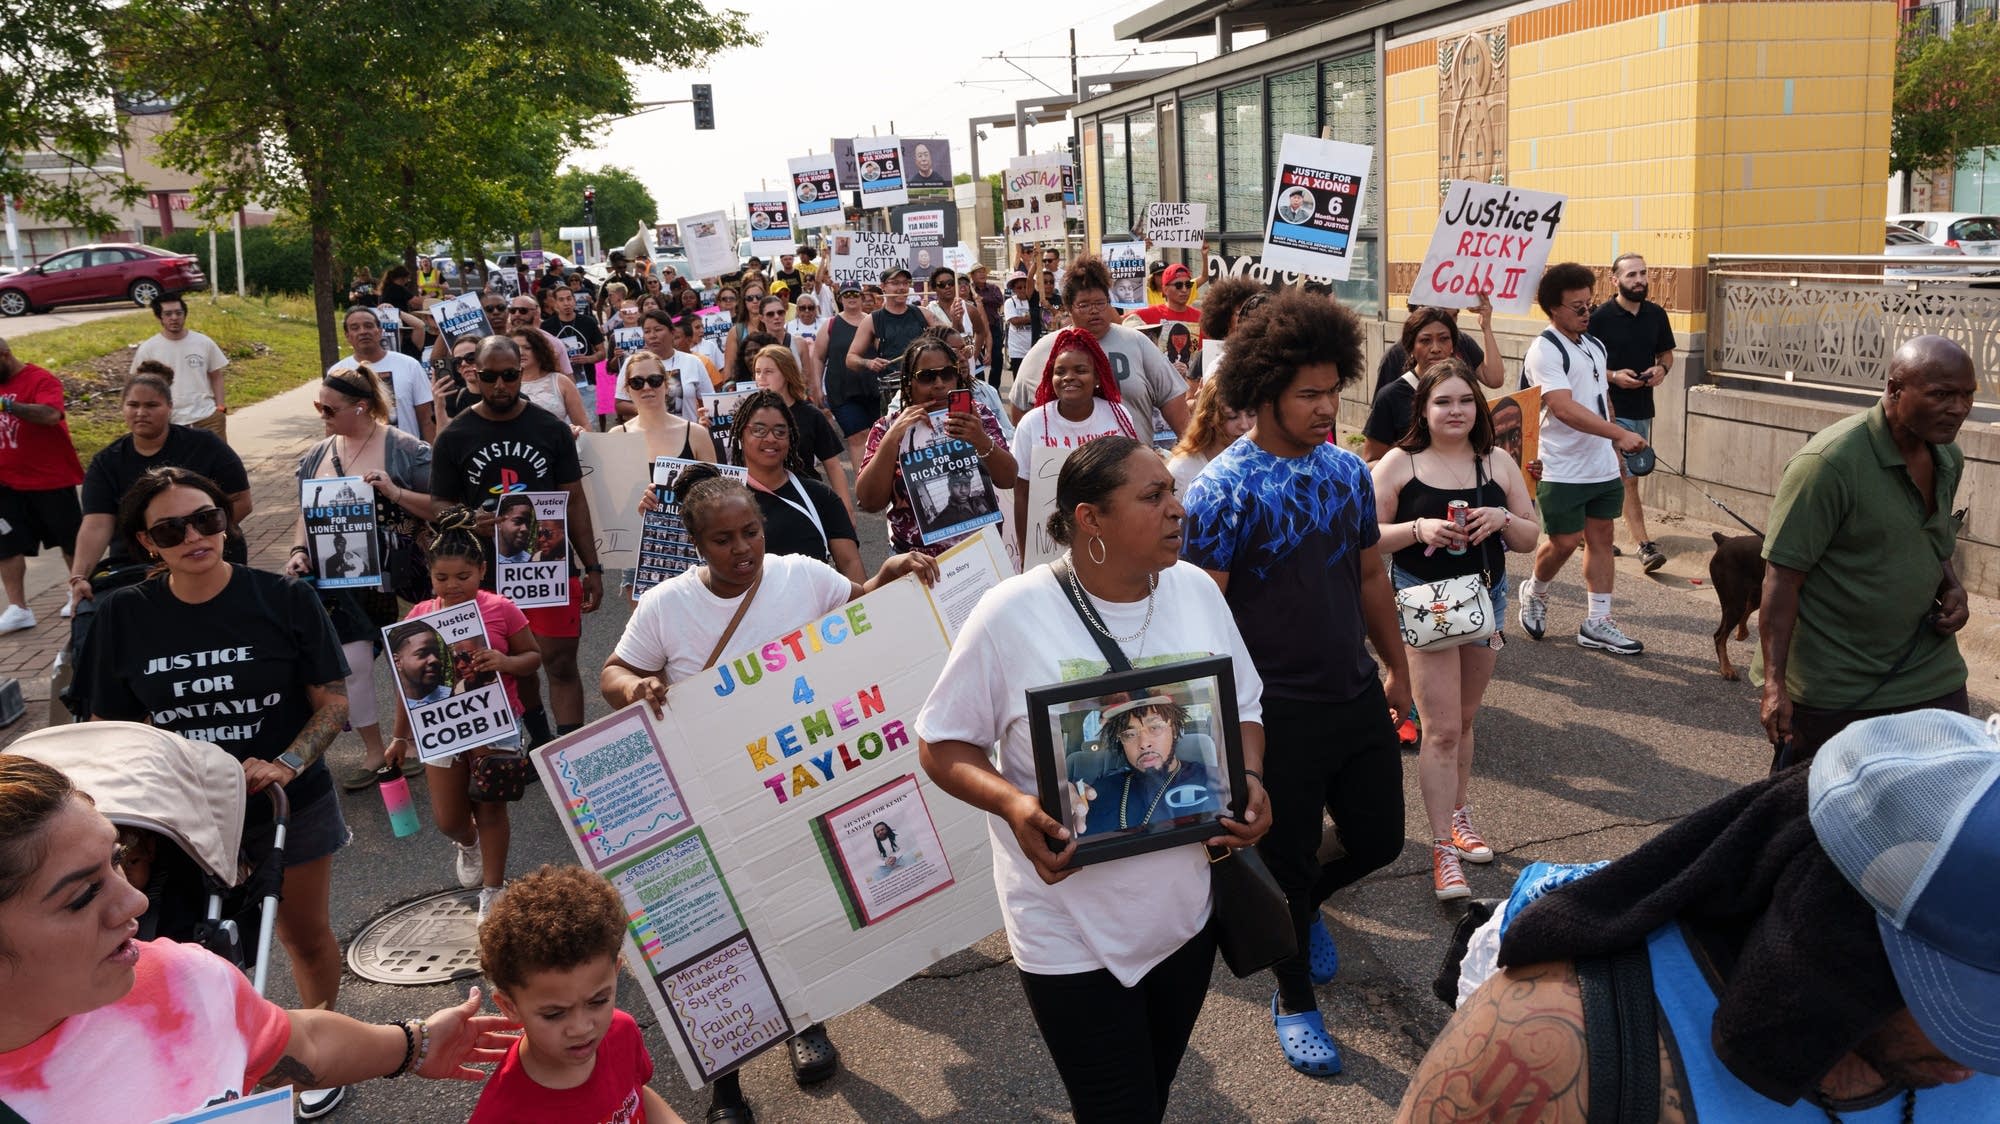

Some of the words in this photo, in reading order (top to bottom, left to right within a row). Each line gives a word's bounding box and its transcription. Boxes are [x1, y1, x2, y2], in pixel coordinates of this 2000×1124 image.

[886, 160, 893, 170] 6
[1010, 171, 1060, 192] CRISTIAN
[1291, 175, 1310, 187] YIA
[1312, 179, 1350, 193] XIONG
[1292, 168, 1331, 180] JUSTICE
[1332, 174, 1352, 183] FOR
[822, 182, 830, 191] 6
[1328, 197, 1343, 215] 6
[1446, 188, 1538, 232] Justice
[1541, 201, 1562, 239] 4
[775, 212, 782, 221] 6
[1324, 221, 1349, 230] JUSTICE
[855, 232, 910, 244] JUSTICIA
[1148, 229, 1204, 242] CRISTIAN
[868, 244, 896, 256] PARA
[1456, 231, 1532, 262] RICKY
[1432, 261, 1494, 296] Cobb
[1497, 268, 1527, 299] II
[442, 310, 483, 328] JUSTICE
[910, 465, 944, 482] RICKY
[948, 455, 979, 471] COBB
[933, 455, 951, 466] FOR
[307, 505, 371, 519] JUSTICE
[665, 505, 679, 514] ALL
[309, 525, 340, 534] LIONEL
[344, 523, 373, 532] LEWIS
[927, 530, 945, 541] JUSTICE
[983, 514, 999, 523] LIVES
[505, 566, 558, 582] RICKY
[947, 570, 955, 578] His
[956, 562, 970, 573] Story
[502, 584, 550, 599] COBB
[555, 583, 565, 596] II
[436, 611, 476, 629] Justice
[452, 627, 469, 637] for
[714, 602, 872, 697] JUSTICE
[144, 646, 254, 674] JUSTICE
[174, 674, 234, 697] FOR
[792, 675, 815, 704] 4
[151, 693, 280, 724] ONTAYLO
[421, 691, 490, 728] RICKY
[422, 717, 489, 750] COBB
[494, 709, 510, 727] II
[746, 684, 886, 772] KEMEN
[764, 720, 909, 804] TAYLOR
[873, 805, 885, 815] FOR
[886, 794, 908, 809] KEMEN
[846, 820, 872, 835] TAYLOR
[676, 941, 749, 985] Minnesota's
[682, 963, 738, 996] Justice
[717, 998, 732, 1011] is
[701, 1003, 754, 1038] Failing
[711, 1017, 760, 1049] Black
